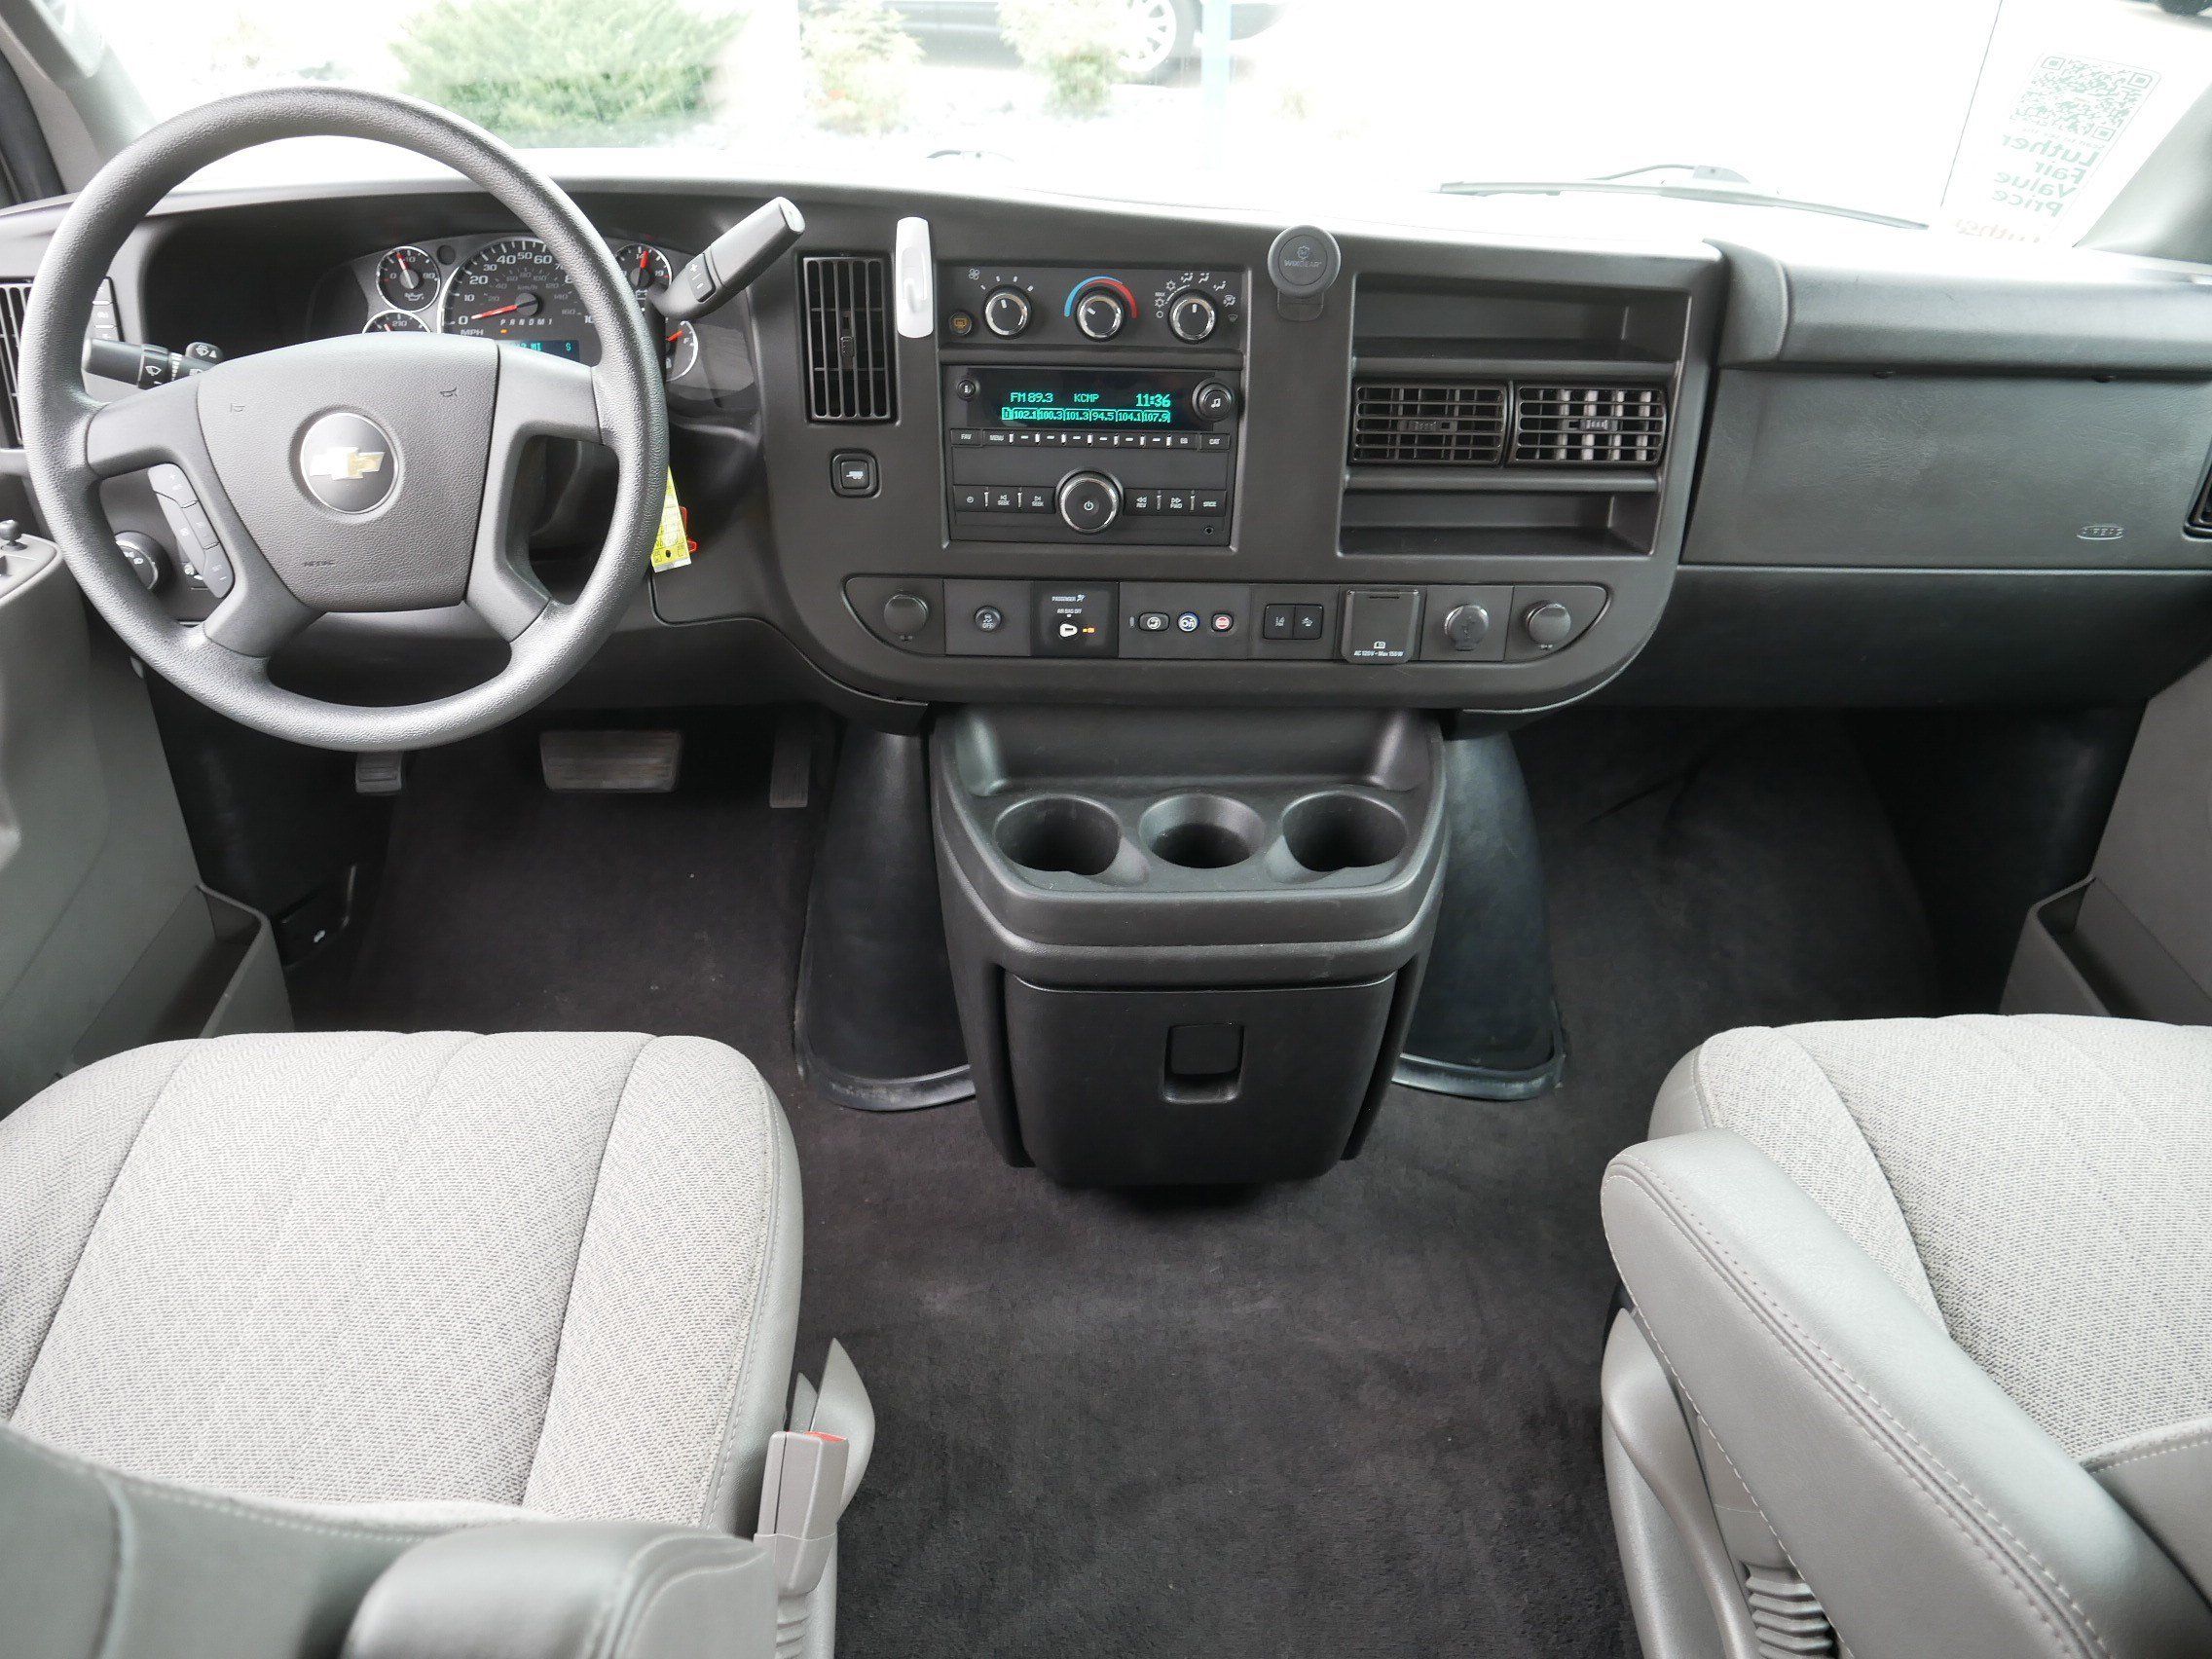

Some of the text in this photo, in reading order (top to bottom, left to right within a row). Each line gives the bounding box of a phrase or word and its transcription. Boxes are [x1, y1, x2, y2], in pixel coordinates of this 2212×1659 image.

[497, 255, 517, 265] 40
[534, 255, 552, 265] 60
[469, 276, 489, 285] 20
[458, 316, 469, 325] 0
[1010, 391, 1171, 408] FM 89.3 KCMP 11:36
[1014, 410, 1037, 420] 102.1
[1038, 410, 1063, 421] 100.3
[1065, 411, 1089, 421] 101.3
[1091, 412, 1115, 422] 94.5
[1118, 412, 1142, 422] 104.1
[1143, 413, 1168, 423] 107.9
